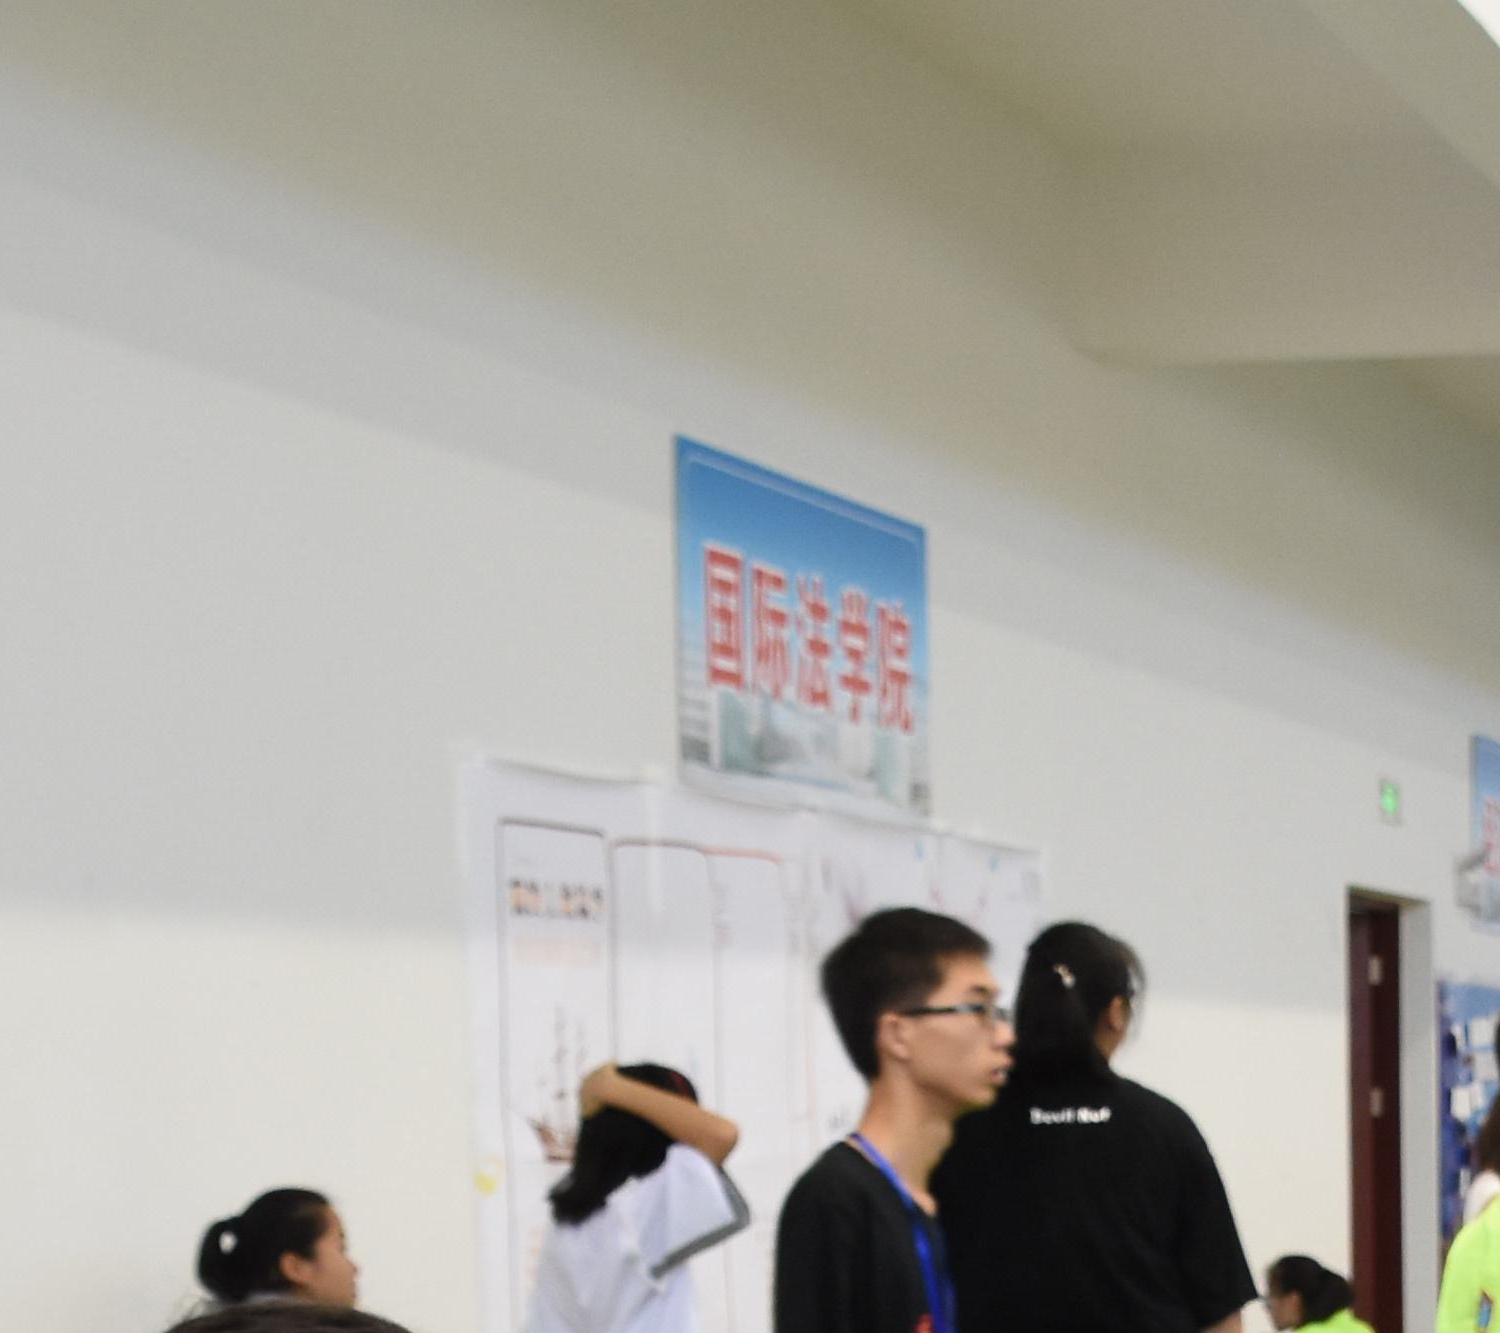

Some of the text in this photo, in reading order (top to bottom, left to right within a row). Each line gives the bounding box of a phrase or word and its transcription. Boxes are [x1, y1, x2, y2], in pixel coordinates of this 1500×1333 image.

[705, 547, 914, 733] 国际法学院
